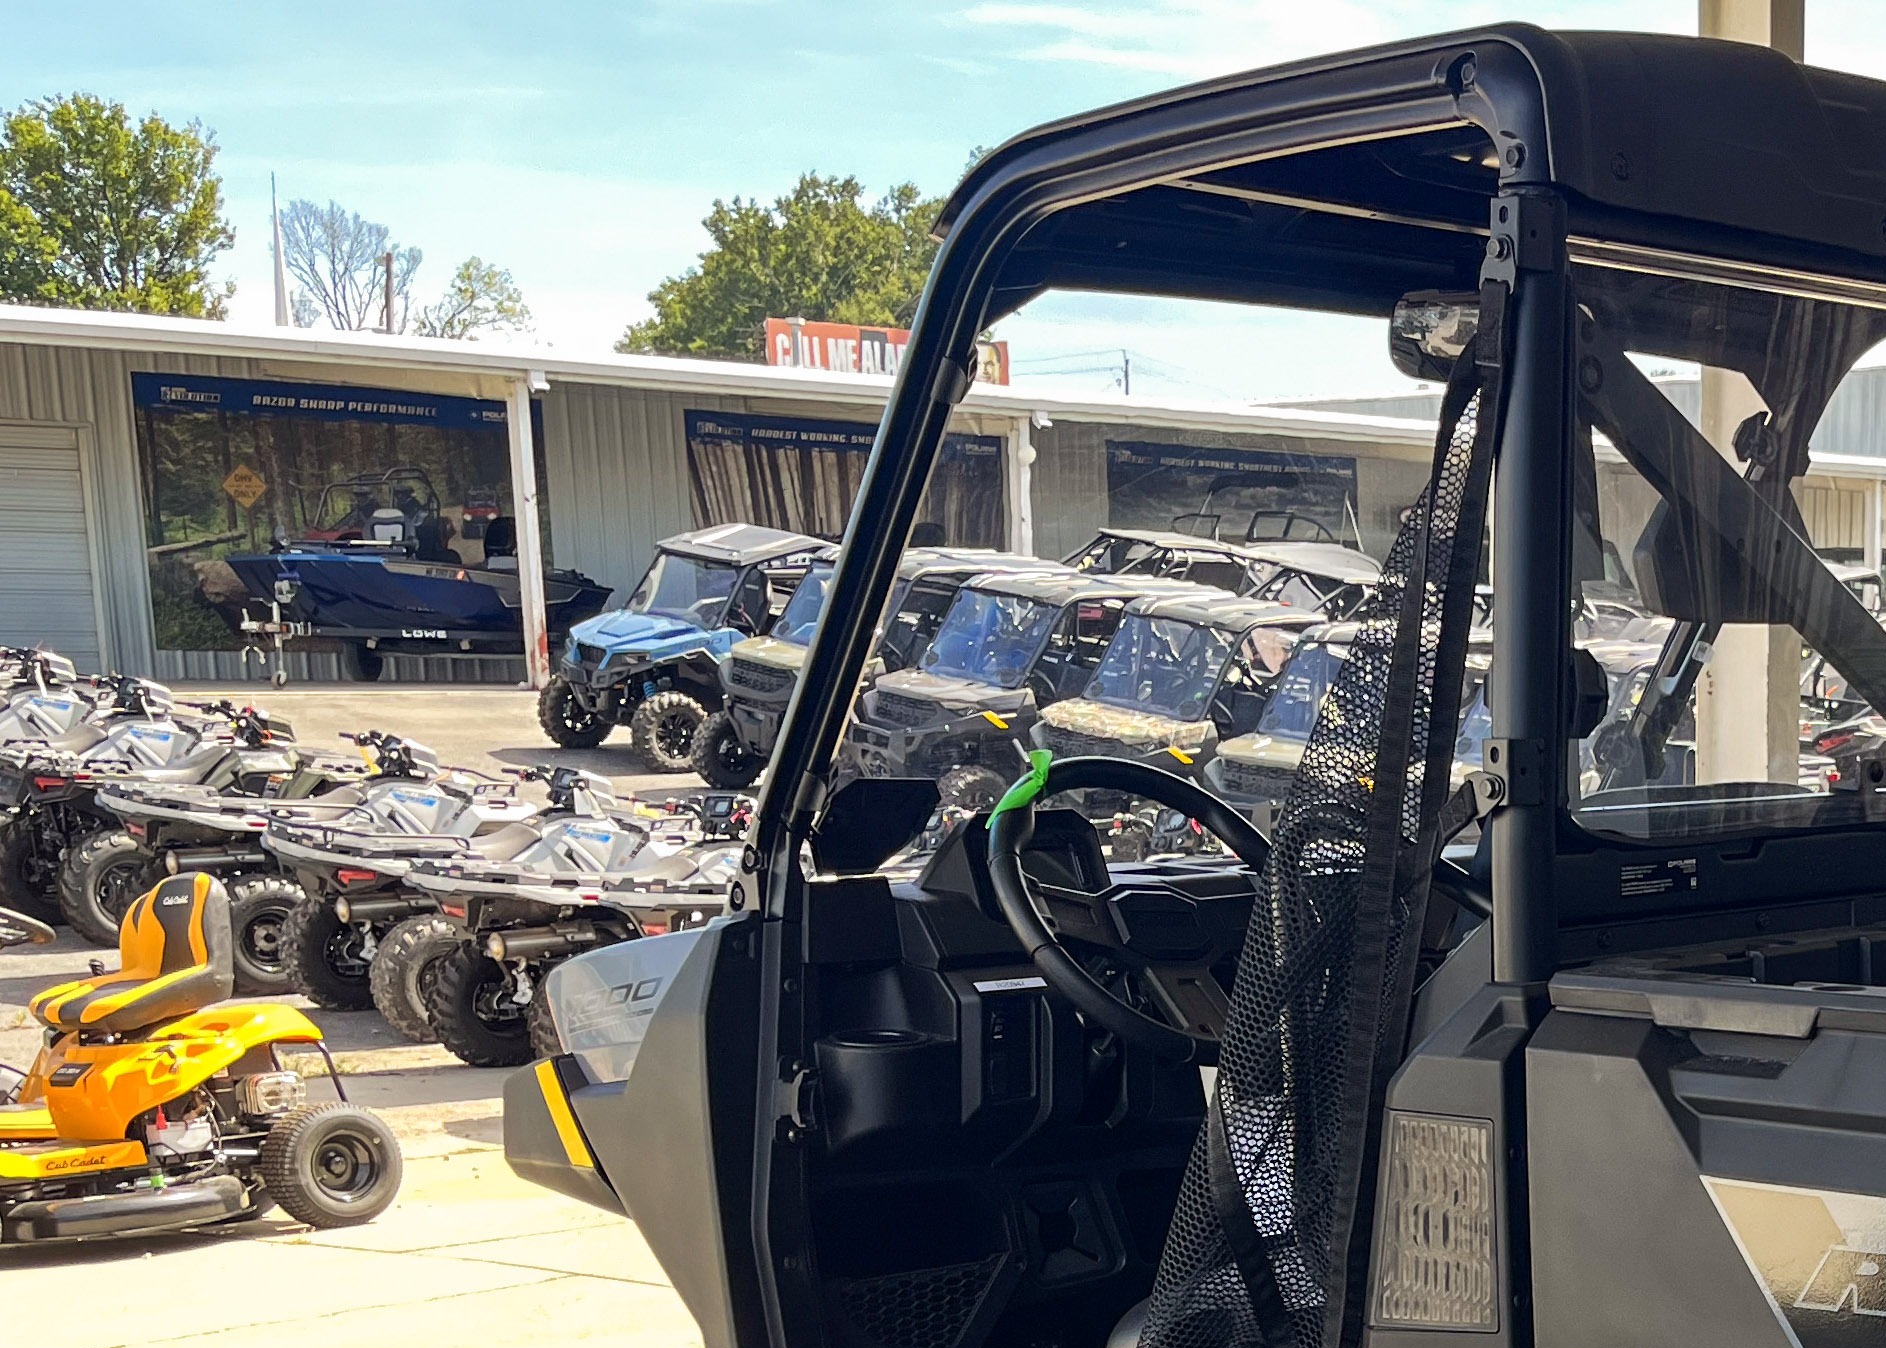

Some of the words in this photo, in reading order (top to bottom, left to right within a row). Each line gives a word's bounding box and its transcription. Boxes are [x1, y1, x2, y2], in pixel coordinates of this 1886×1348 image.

[775, 332, 821, 370] CLL
[827, 337, 859, 373] ME
[253, 395, 296, 408] RAZOR
[300, 398, 345, 411] SHARP
[348, 401, 438, 417] PERFORMANCE
[751, 428, 798, 440] HARDEST
[401, 629, 448, 639] LOWE
